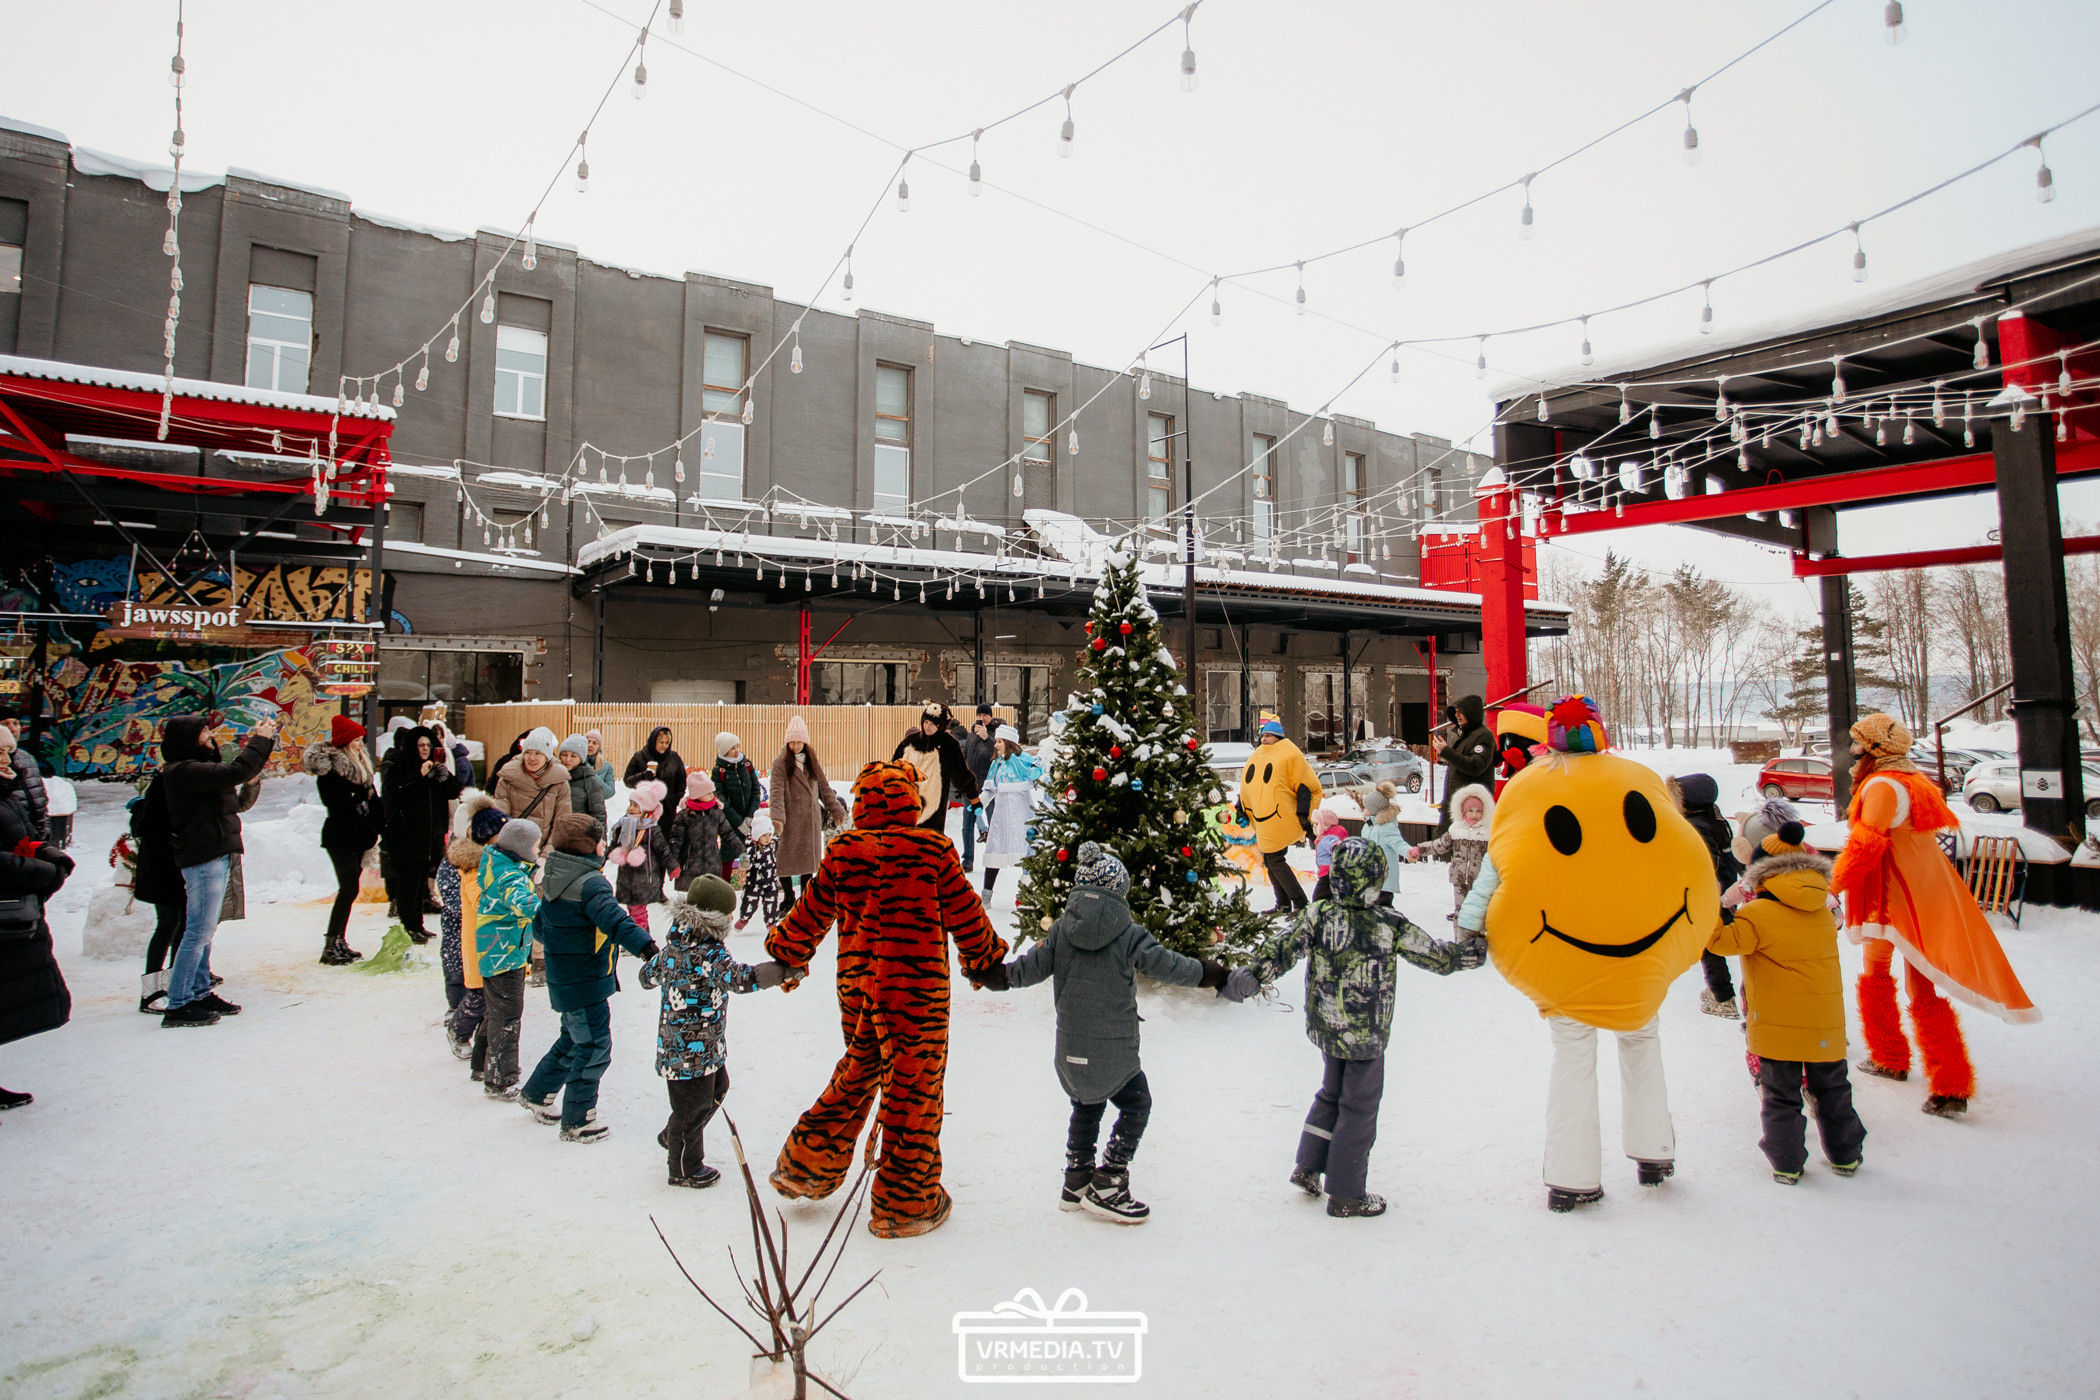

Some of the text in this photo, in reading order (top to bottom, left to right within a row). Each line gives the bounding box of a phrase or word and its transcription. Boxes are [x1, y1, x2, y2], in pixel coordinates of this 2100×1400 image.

[120, 603, 240, 631] jawsspot
[335, 643, 365, 654] S?X
[333, 664, 369, 674] CHILL
